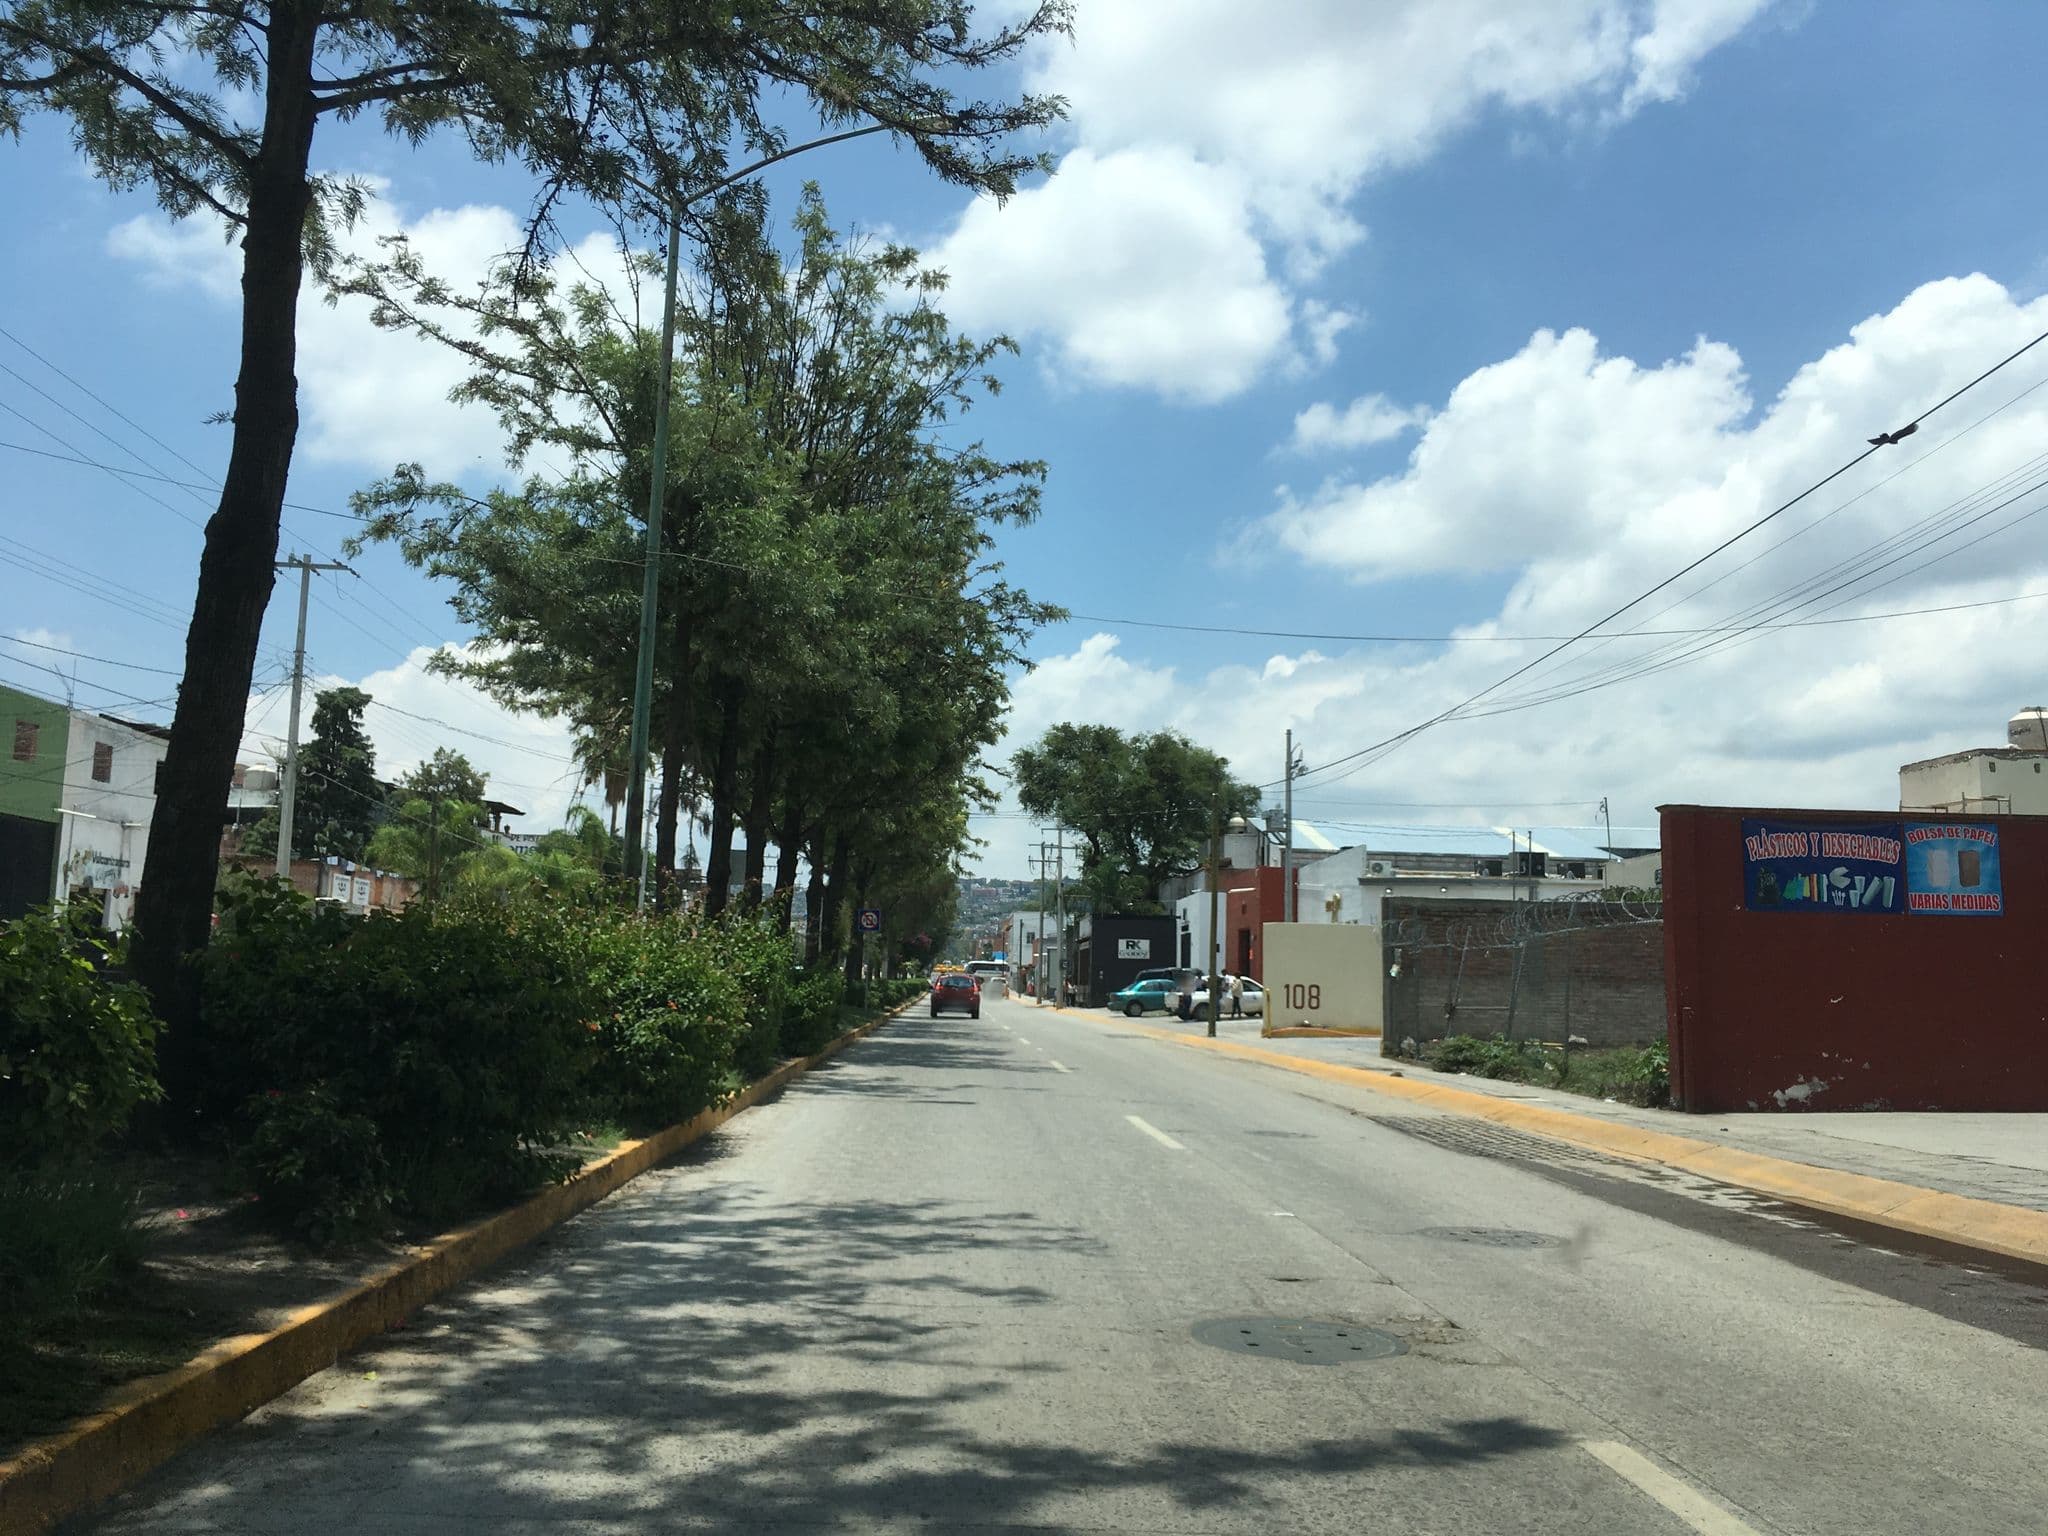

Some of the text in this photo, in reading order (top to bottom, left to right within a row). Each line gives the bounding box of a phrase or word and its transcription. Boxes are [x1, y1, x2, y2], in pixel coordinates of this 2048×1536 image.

[1745, 828, 1901, 864] PLÁSTICOS Y DESECHABLES
[1907, 827, 1998, 847] BOLSA DE PAPEL
[1909, 892, 2001, 912] VARIAS MEDIDAS
[1126, 940, 1141, 950] RK
[1284, 984, 1320, 1009] 108
